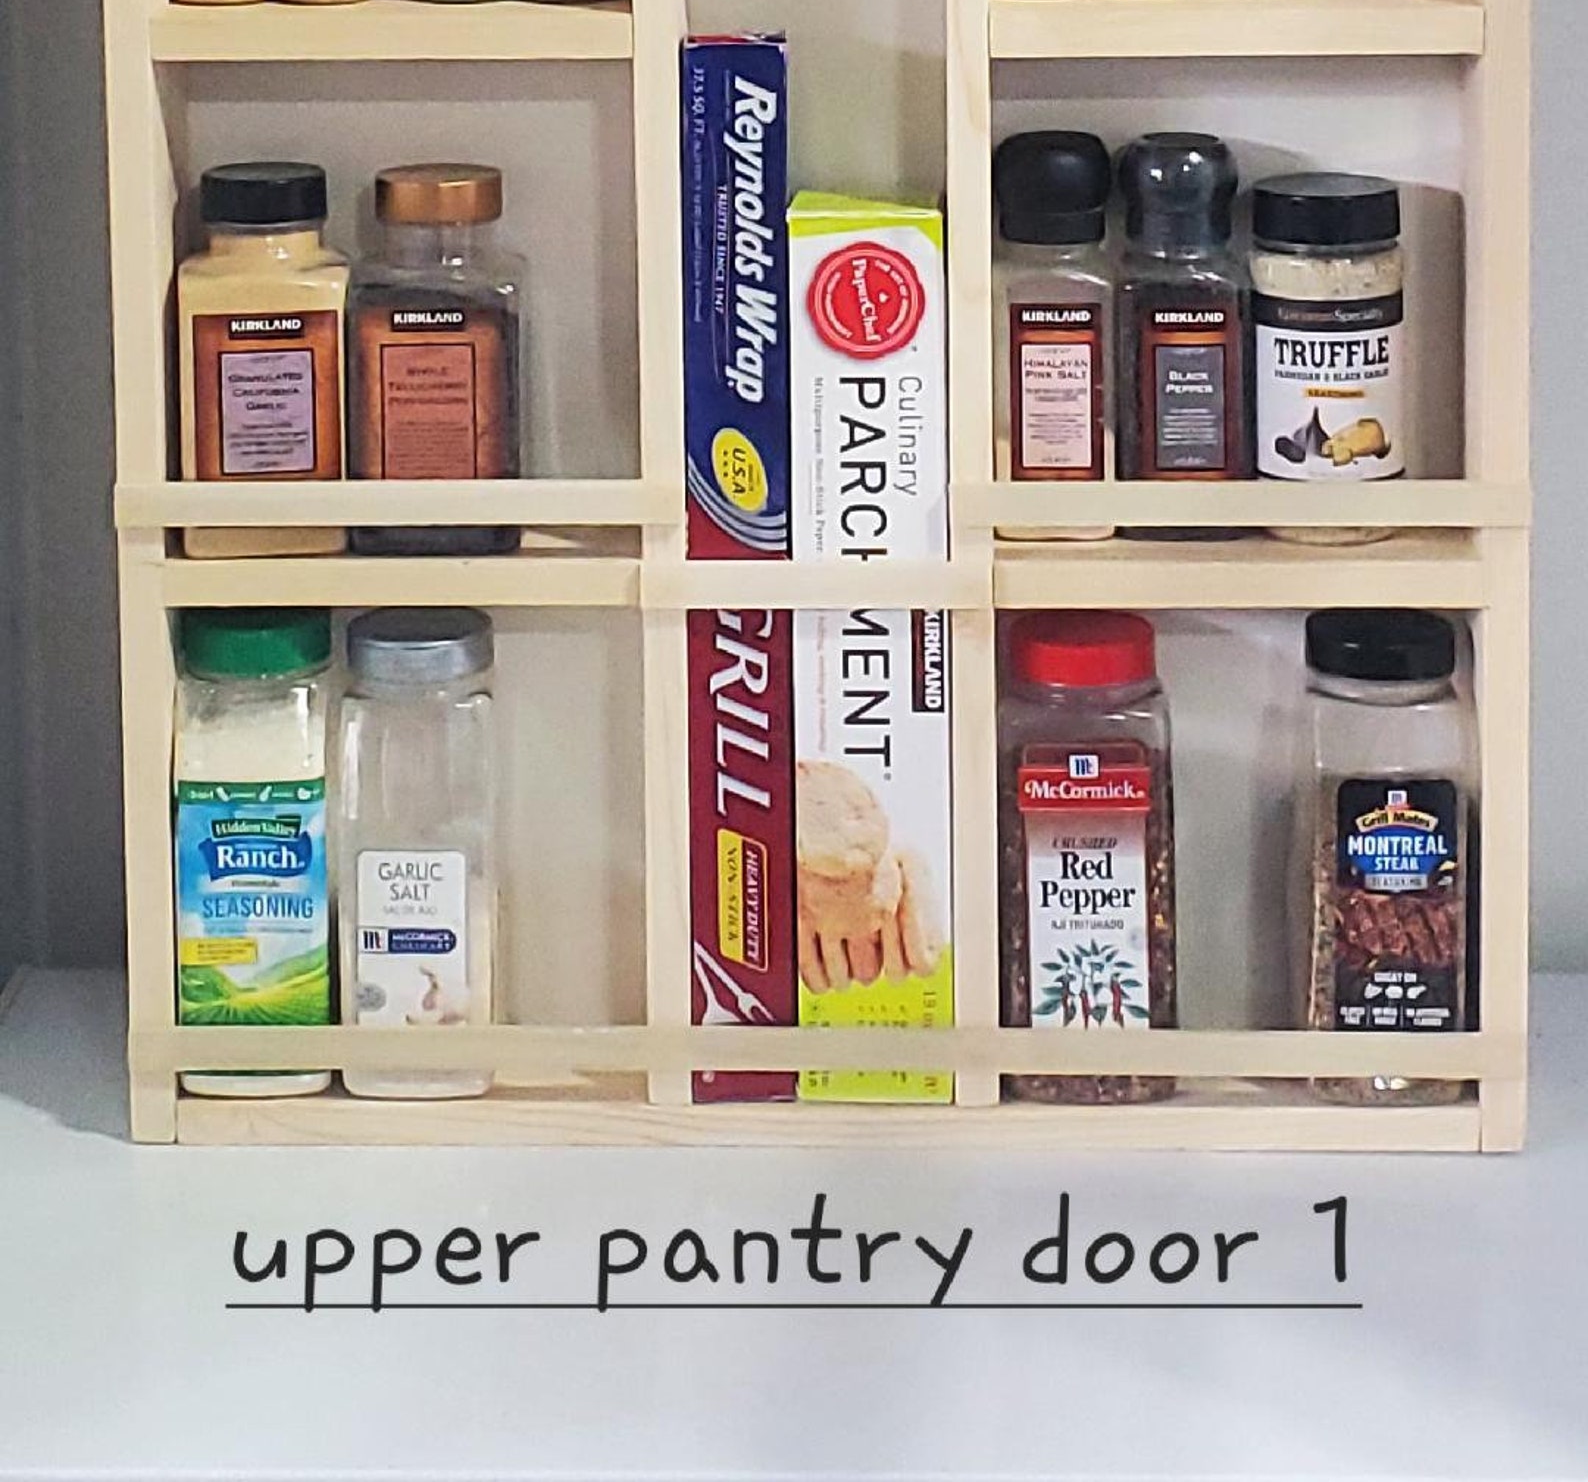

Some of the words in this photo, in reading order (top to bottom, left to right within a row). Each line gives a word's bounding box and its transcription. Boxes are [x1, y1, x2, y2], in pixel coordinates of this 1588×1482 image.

[723, 75, 778, 282] Reynolds
[231, 319, 302, 333] KIRKLAND
[393, 312, 464, 324] KIRKLAND
[1022, 309, 1091, 322] KIRKLAND
[1155, 312, 1225, 324] KIRKLAND
[724, 284, 778, 403] Wrap
[1273, 335, 1390, 368] TRUFFLE
[893, 376, 923, 496] Culinary
[1023, 779, 1139, 799] McCormick
[215, 822, 261, 836] Hidden
[1347, 834, 1448, 856] MONTREAL
[216, 845, 298, 869] Ranch
[1060, 851, 1113, 880] Red
[1373, 856, 1420, 871] STEAK
[378, 862, 444, 882] GARLIC
[389, 883, 431, 901] SALT
[1040, 880, 1137, 915] Pepper
[202, 895, 314, 919] SEASONING
